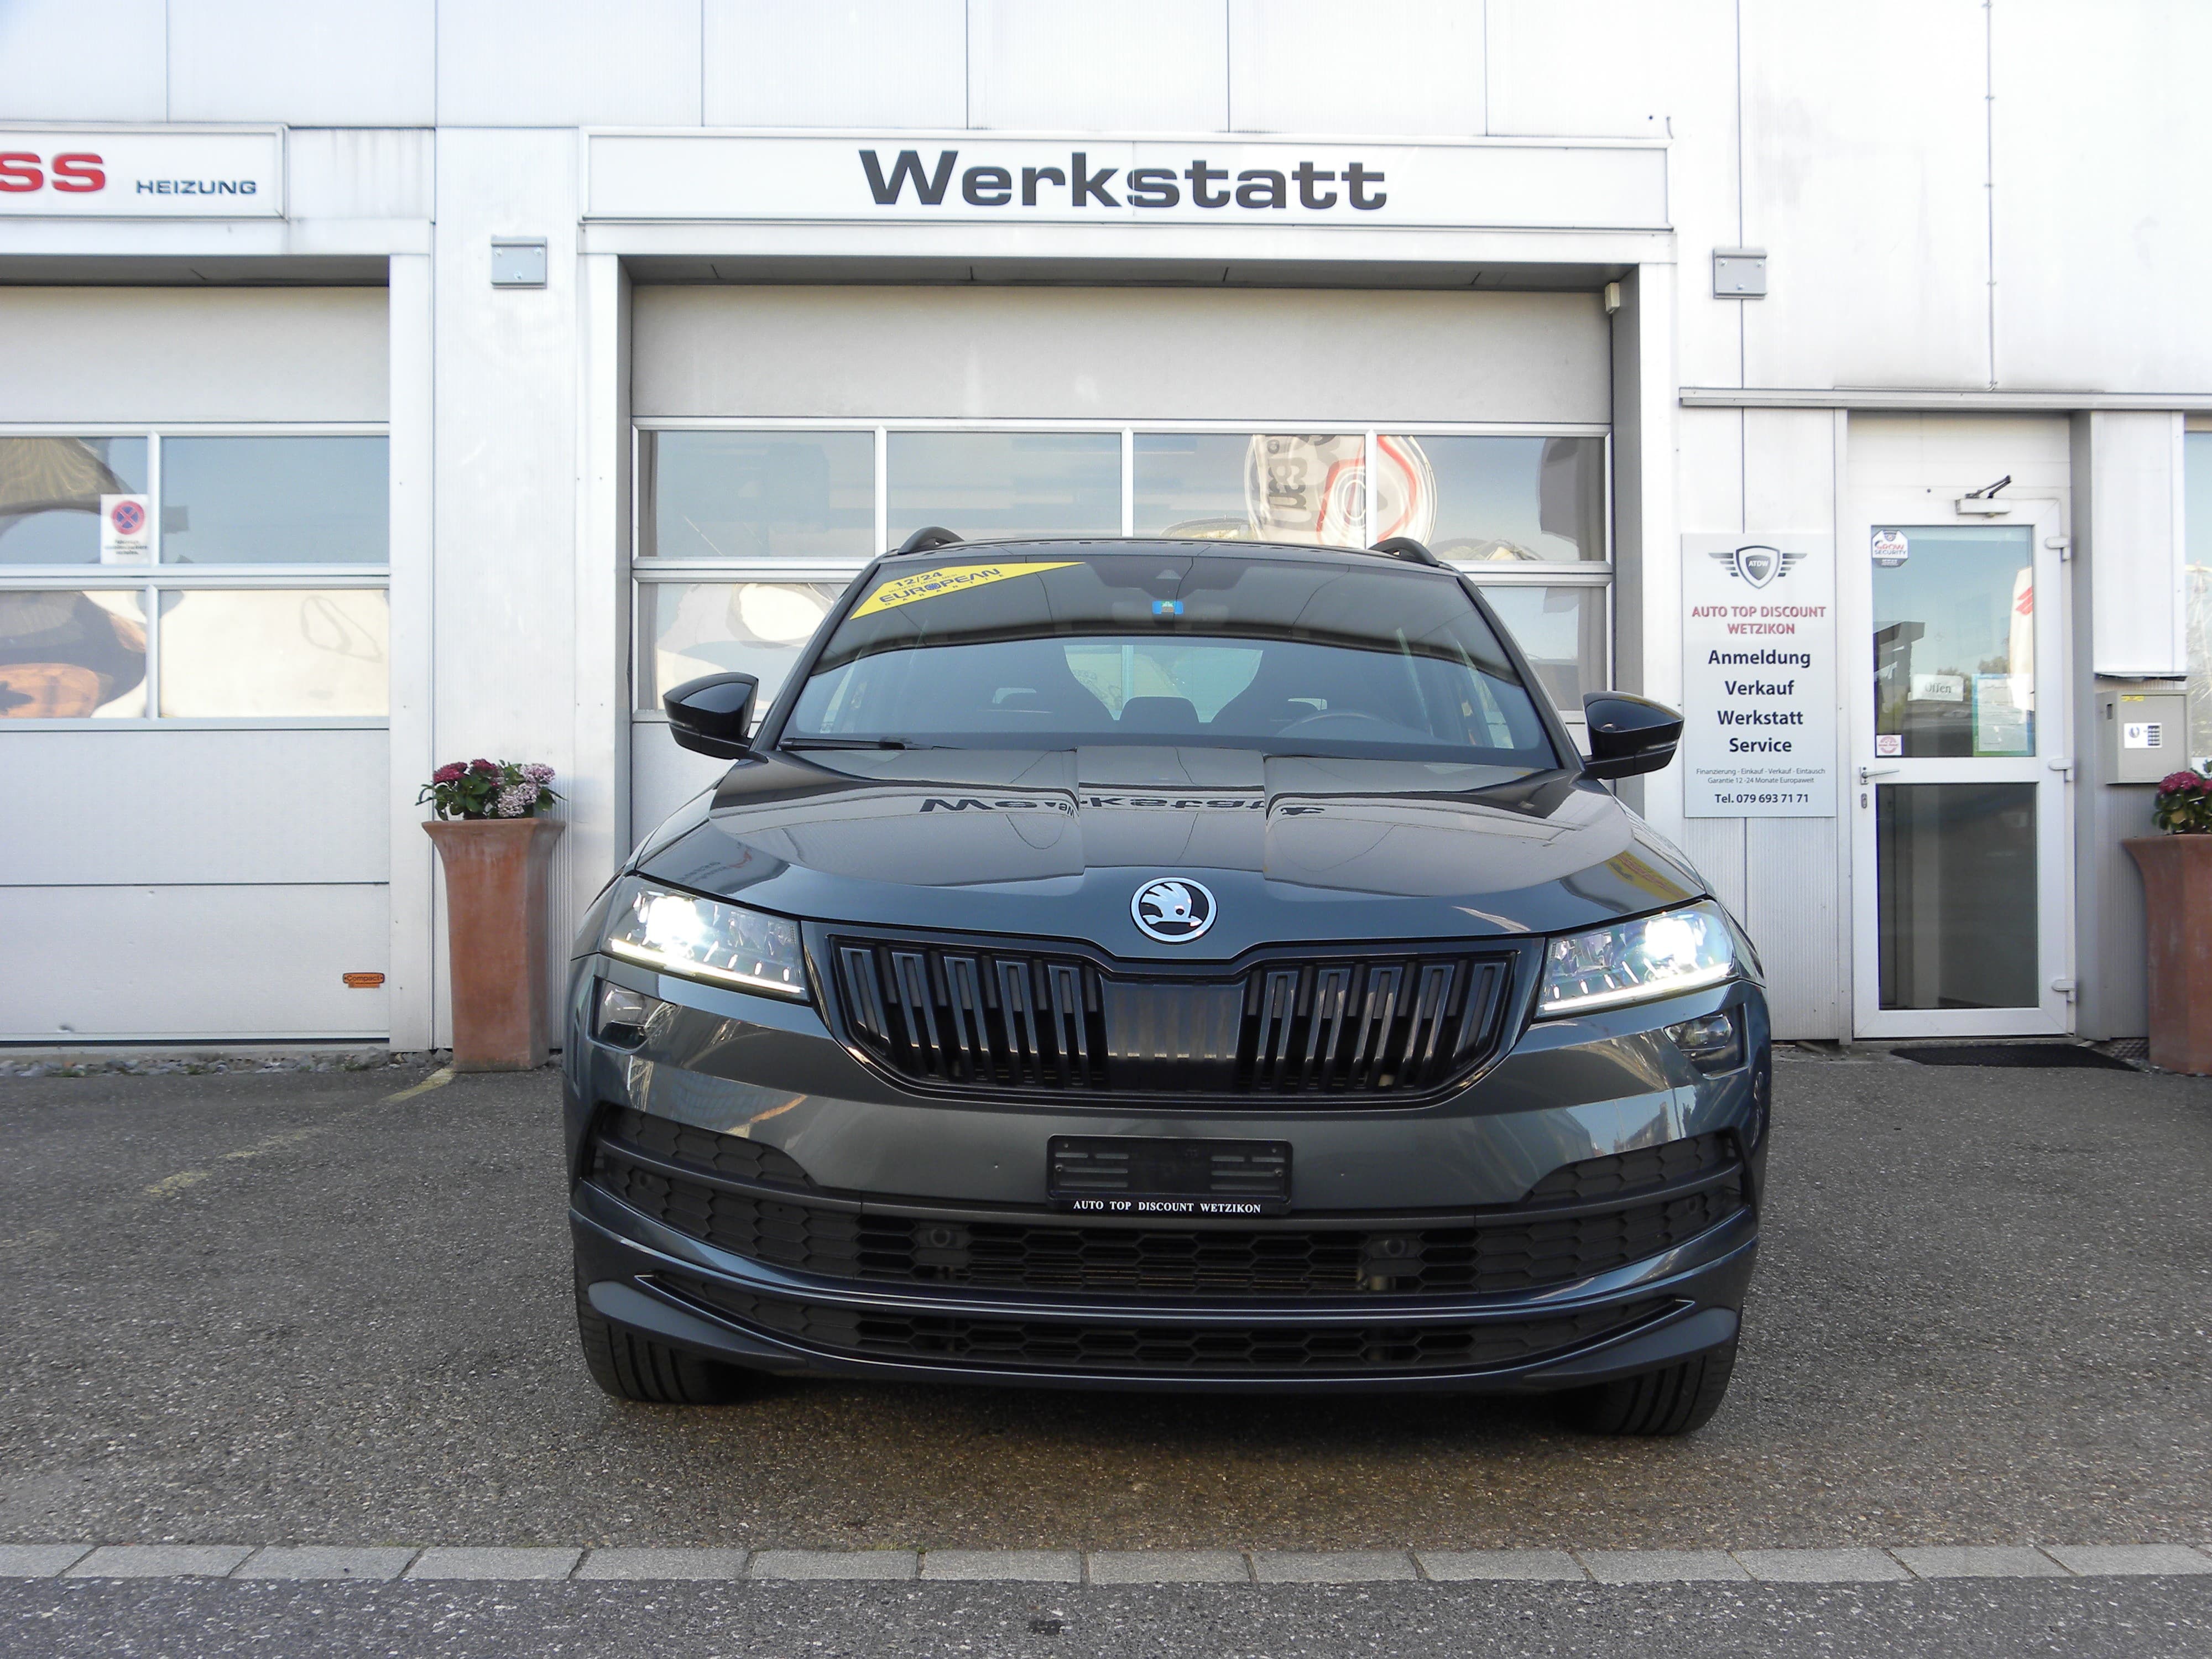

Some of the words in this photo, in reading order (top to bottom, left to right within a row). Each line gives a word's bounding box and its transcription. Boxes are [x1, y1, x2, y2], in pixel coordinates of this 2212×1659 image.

[858, 149, 1387, 210] Werkstatt
[136, 180, 257, 195] HEIZUNG
[879, 568, 1001, 603] EUROPEAN
[894, 571, 943, 587] 12/24
[1692, 606, 1728, 618] AUTO
[1731, 606, 1757, 618] TOP
[1760, 606, 1827, 618] DISCOUNT
[1727, 623, 1795, 634] WETZIKON
[1708, 649, 1811, 669] Anmeldung
[1724, 680, 1795, 695] Verkauf
[1924, 681, 1952, 693] Offen
[1717, 709, 1804, 725] Werkstatt
[1729, 737, 1792, 752] Service
[1714, 794, 1734, 803] Tel.
[1736, 794, 1756, 803] 079
[1759, 794, 1778, 803] 693
[1781, 794, 1793, 803] 71
[1796, 794, 1809, 803] 71
[1073, 1200, 1104, 1211] AUTO
[1109, 1201, 1131, 1211] TOP
[1138, 1202, 1194, 1213] DISCOUNT
[1199, 1203, 1261, 1213] WETZIKON
